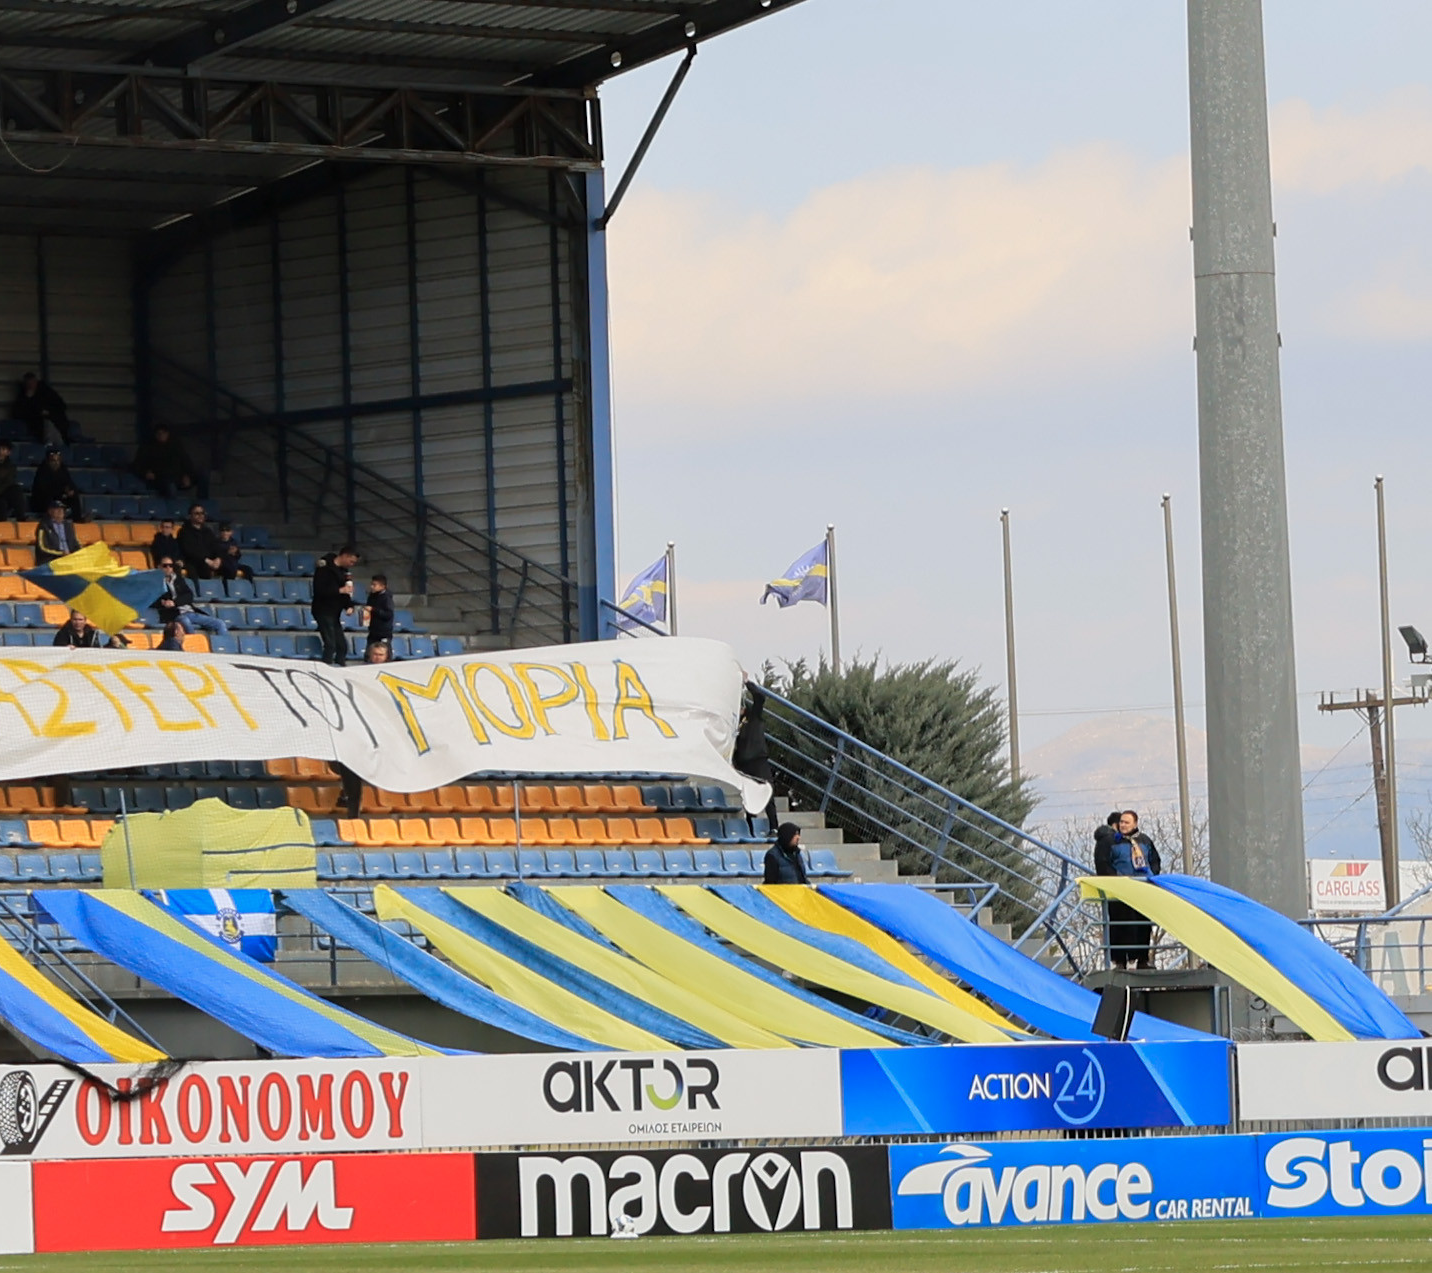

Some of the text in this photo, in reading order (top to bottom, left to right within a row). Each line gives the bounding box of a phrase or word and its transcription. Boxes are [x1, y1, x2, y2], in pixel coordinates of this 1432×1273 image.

[231, 662, 379, 749] ΤΟΥ
[376, 657, 678, 756] ΜΟΡΙΑ
[1316, 880, 1380, 896] CARGLASS
[969, 1059, 1096, 1104] ACTION 24
[628, 1121, 722, 1134] ΟΜΙΛΟΣ ΕΤΑΙΡΕΙΩΝ
[161, 1160, 354, 1244] SYM
[518, 1150, 853, 1237] macron
[944, 1160, 1253, 1226] avance CAR RENTAL
